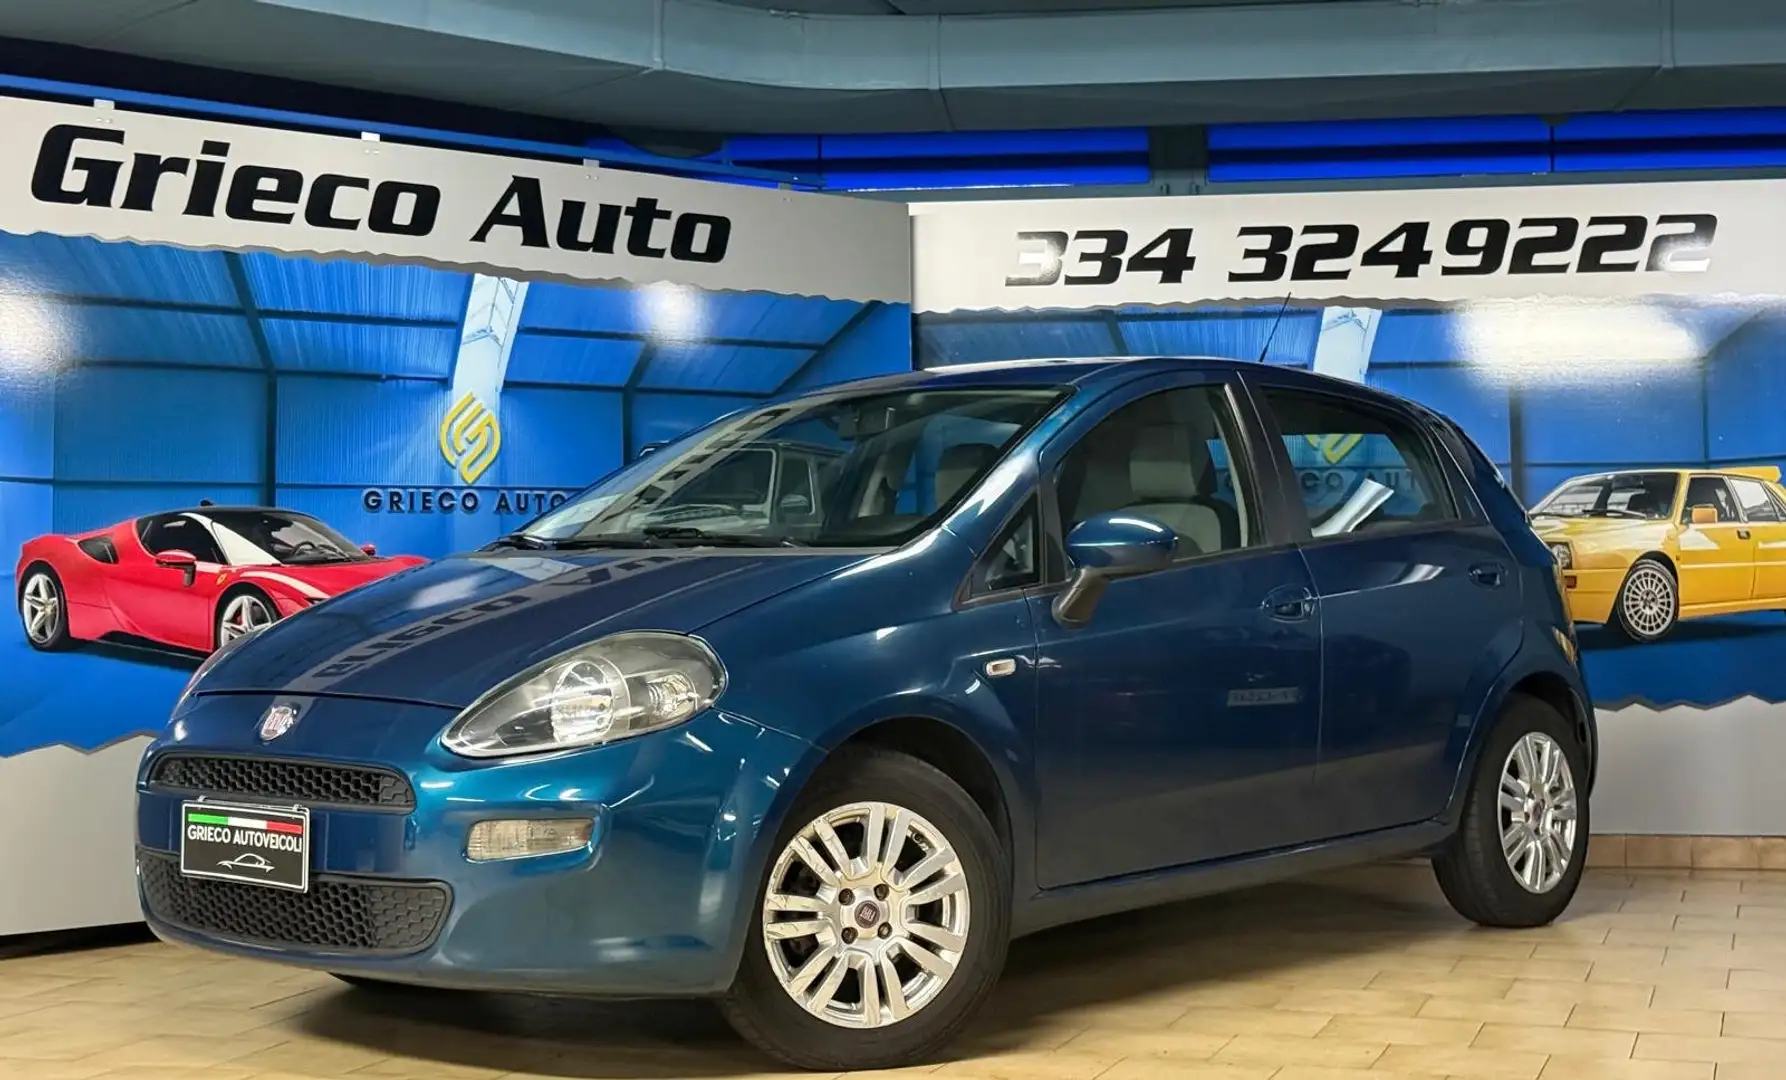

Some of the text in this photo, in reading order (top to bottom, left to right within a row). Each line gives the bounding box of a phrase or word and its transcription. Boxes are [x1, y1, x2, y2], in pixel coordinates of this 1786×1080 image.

[30, 122, 732, 264] Grieco Auto
[1004, 213, 1718, 287] 334 3249222
[362, 487, 480, 514] GRIECO
[187, 825, 302, 852] GRIECO AUTOVEICOLI
